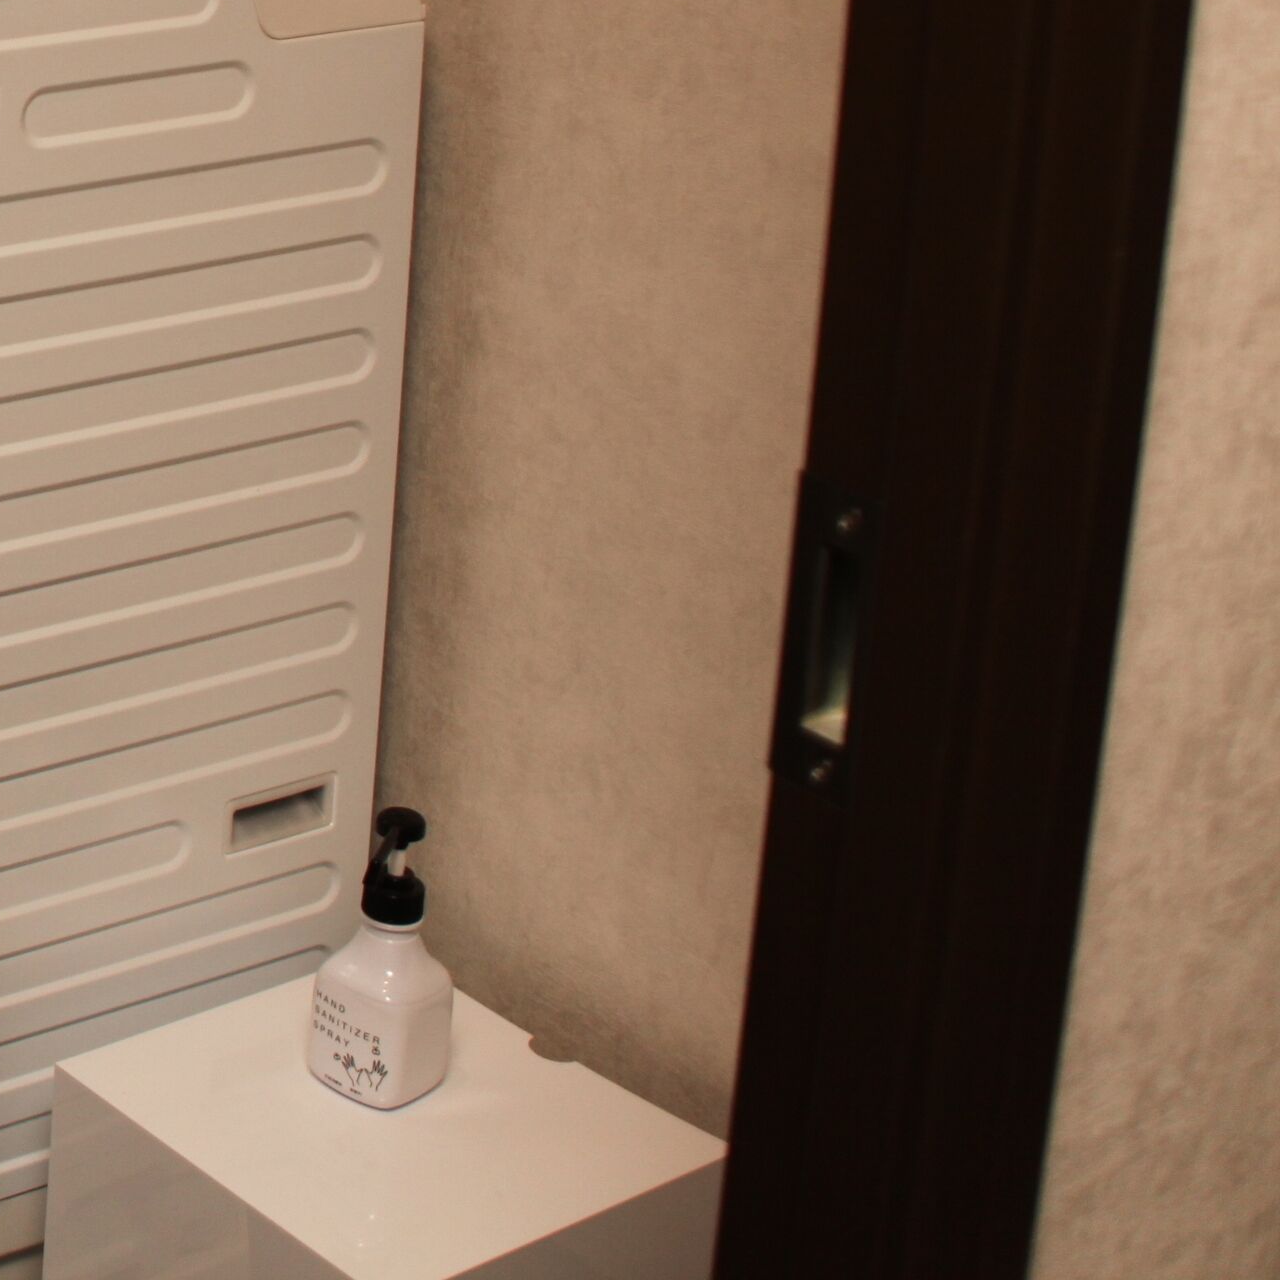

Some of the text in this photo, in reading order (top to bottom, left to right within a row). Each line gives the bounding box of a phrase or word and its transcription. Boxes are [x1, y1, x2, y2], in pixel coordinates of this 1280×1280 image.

[315, 989, 346, 1014] HAND
[313, 1019, 351, 1047] SPRAY
[314, 1003, 381, 1045] SANITIZER
